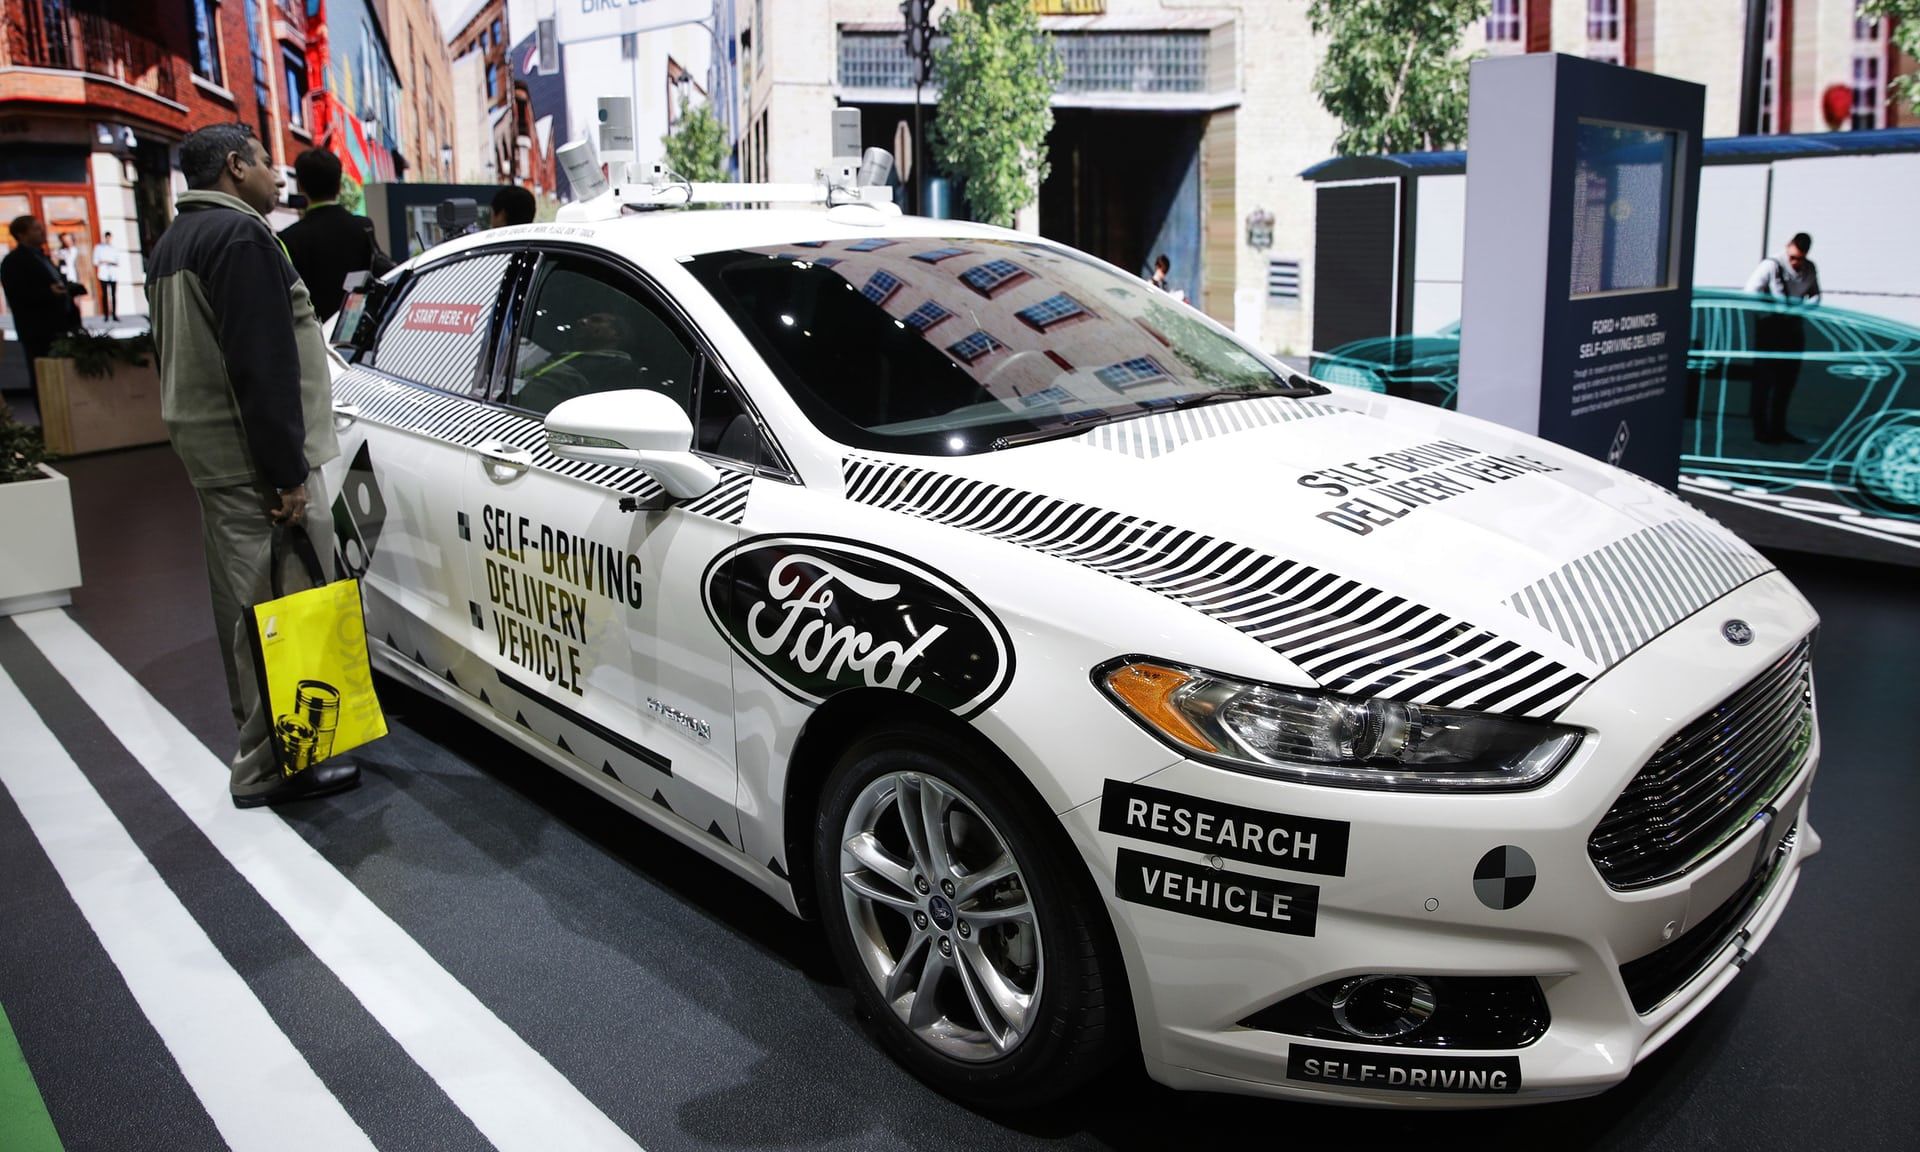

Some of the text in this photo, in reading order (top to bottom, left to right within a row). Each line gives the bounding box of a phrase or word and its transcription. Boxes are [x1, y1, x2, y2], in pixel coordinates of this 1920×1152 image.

[413, 308, 464, 326] START HERE
[1592, 318, 1615, 335] FORD
[1296, 440, 1481, 497] SELF-DRIVIN
[1315, 471, 1475, 537] DELIVERY
[483, 504, 643, 610] SELF-DRIVING
[486, 558, 587, 645] DELIVERY
[747, 553, 949, 694] Ford
[493, 610, 583, 697] VEHICLE
[1127, 798, 1318, 861] RESEARCH
[1142, 867, 1293, 921] VEHICLE
[1304, 1058, 1508, 1090] SELF-DRIVING
